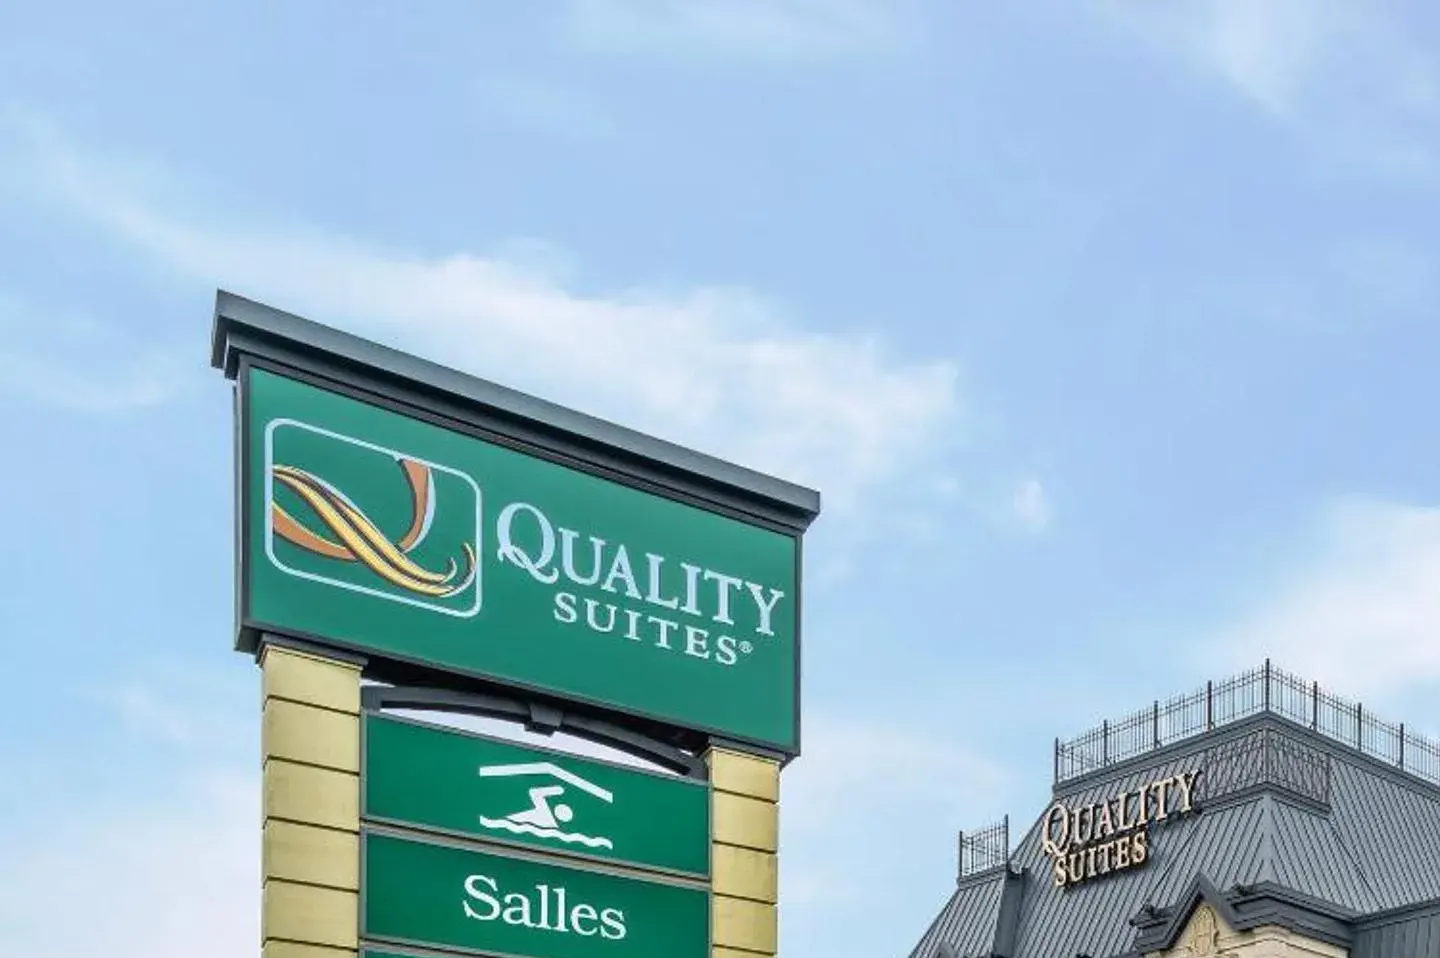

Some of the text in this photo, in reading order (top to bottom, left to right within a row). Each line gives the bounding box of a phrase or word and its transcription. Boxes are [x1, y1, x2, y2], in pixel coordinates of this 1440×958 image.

[496, 503, 784, 636] QUALITY
[1043, 769, 1201, 857] QUALITY
[1054, 831, 1147, 887] SUITES
[462, 874, 627, 940] Salles
